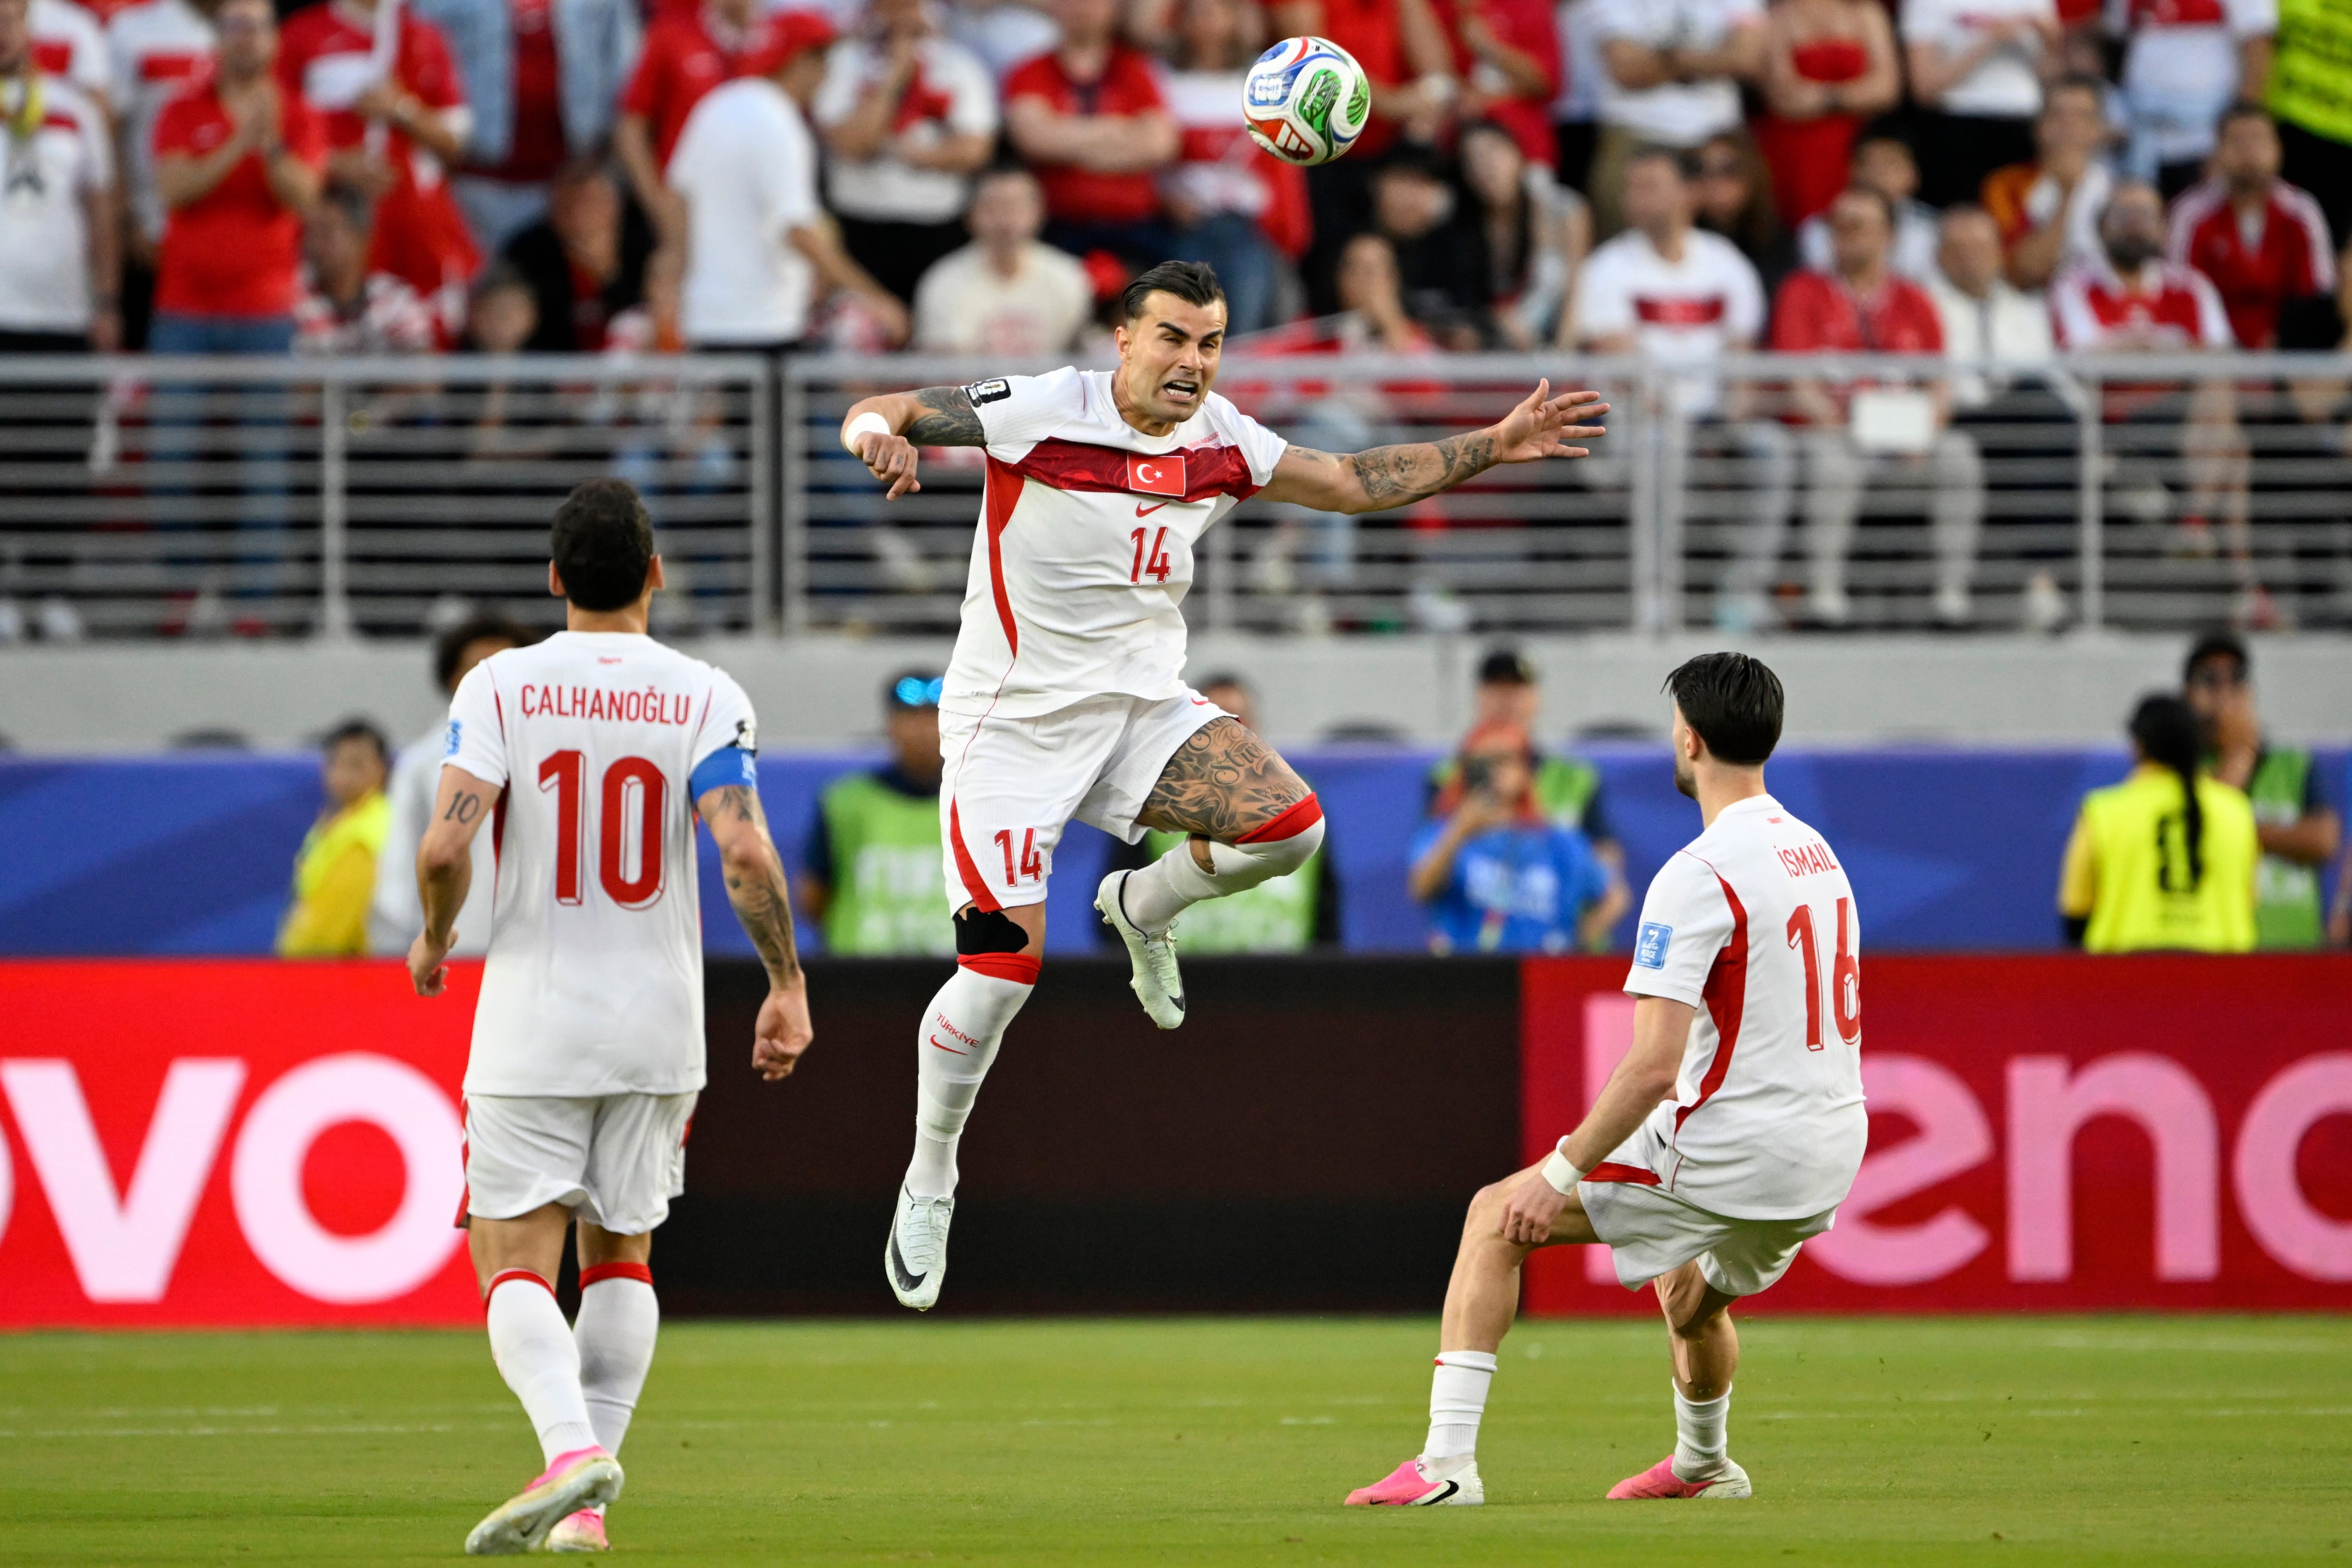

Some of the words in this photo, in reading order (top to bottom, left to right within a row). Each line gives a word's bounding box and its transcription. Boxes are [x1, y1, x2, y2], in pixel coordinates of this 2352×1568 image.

[1130, 526, 1171, 585] 14
[521, 685, 690, 725] ÇALHANOĞLU
[444, 791, 480, 825] 10
[538, 749, 669, 912] 10
[994, 828, 1042, 887] 14
[1773, 838, 1838, 878] İSMAİL
[1786, 897, 1861, 1052] 16
[937, 1012, 980, 1048] TÜRKİYE
[0, 1051, 467, 1304] vo
